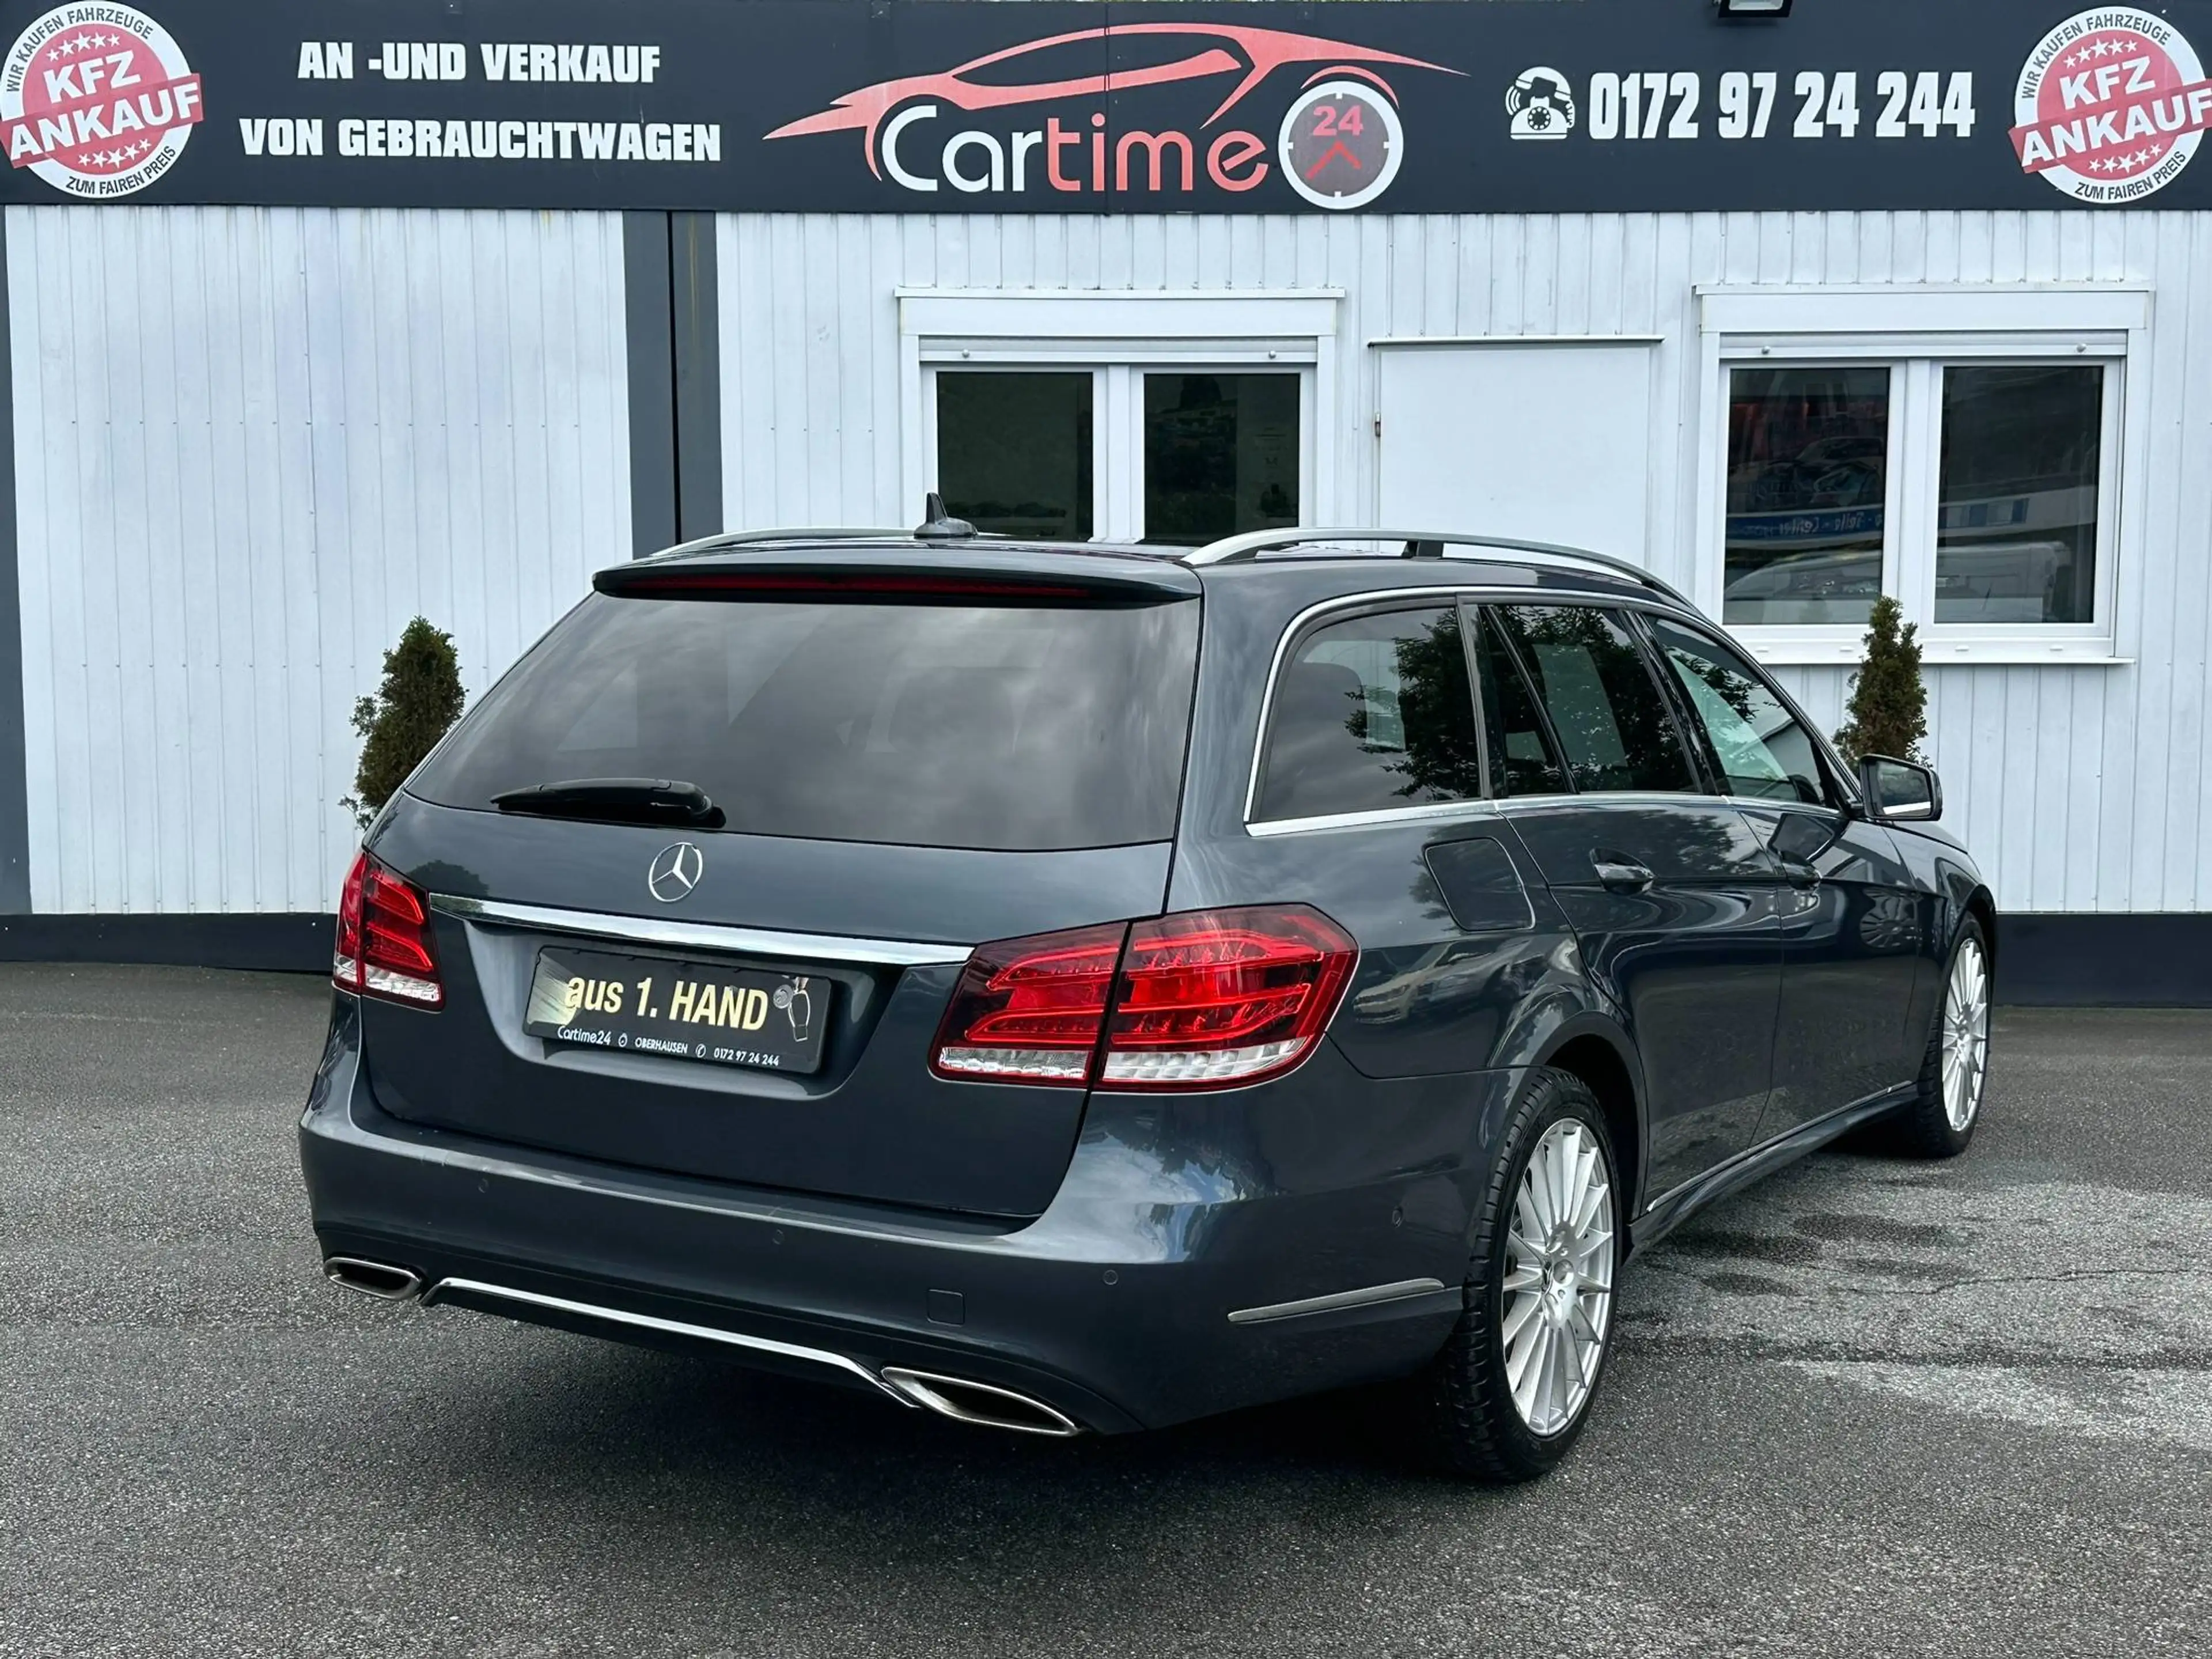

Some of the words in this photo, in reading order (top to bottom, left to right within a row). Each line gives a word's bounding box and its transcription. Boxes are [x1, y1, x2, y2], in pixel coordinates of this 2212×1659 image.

[6, 63, 25, 92] WIR
[16, 15, 65, 63] KAUFEN
[67, 7, 154, 40] FAHRZEUGE
[43, 50, 141, 104] KFZ
[298, 42, 354, 79] AN
[480, 43, 660, 83] VERKAUF
[2021, 71, 2041, 99] WIR
[2033, 21, 2084, 70] KAUFEN
[2086, 14, 2171, 46] FAHRZEUGE
[1589, 71, 1700, 140] 0172
[1718, 71, 1777, 138] 97
[1793, 71, 1860, 138] 24
[1875, 71, 1976, 138] 244
[2059, 56, 2157, 111] KFZ
[10, 82, 200, 161] ANKAUF
[238, 119, 323, 156] VON
[338, 119, 721, 161] GEBRAUCHTWAGEN
[882, 104, 1268, 193] Cartime
[1312, 105, 1364, 137] 24
[2021, 88, 2212, 167] ANKAUF
[66, 176, 96, 195] ZUM
[99, 172, 145, 195] FAIREN
[145, 145, 176, 180] PREIS
[2074, 181, 2104, 200] ZUM
[2108, 176, 2153, 200] FAIREN
[2153, 150, 2187, 184] PREIS
[565, 976, 624, 1013] aus
[637, 977, 658, 1018] 1.
[669, 980, 768, 1031] HAND
[557, 1025, 612, 1046] Cartime24
[635, 1037, 689, 1054] OBERHAUSEN
[714, 1047, 734, 1060] 0172
[736, 1050, 748, 1062] 97
[748, 1052, 760, 1064] 24
[762, 1054, 781, 1067] 244
